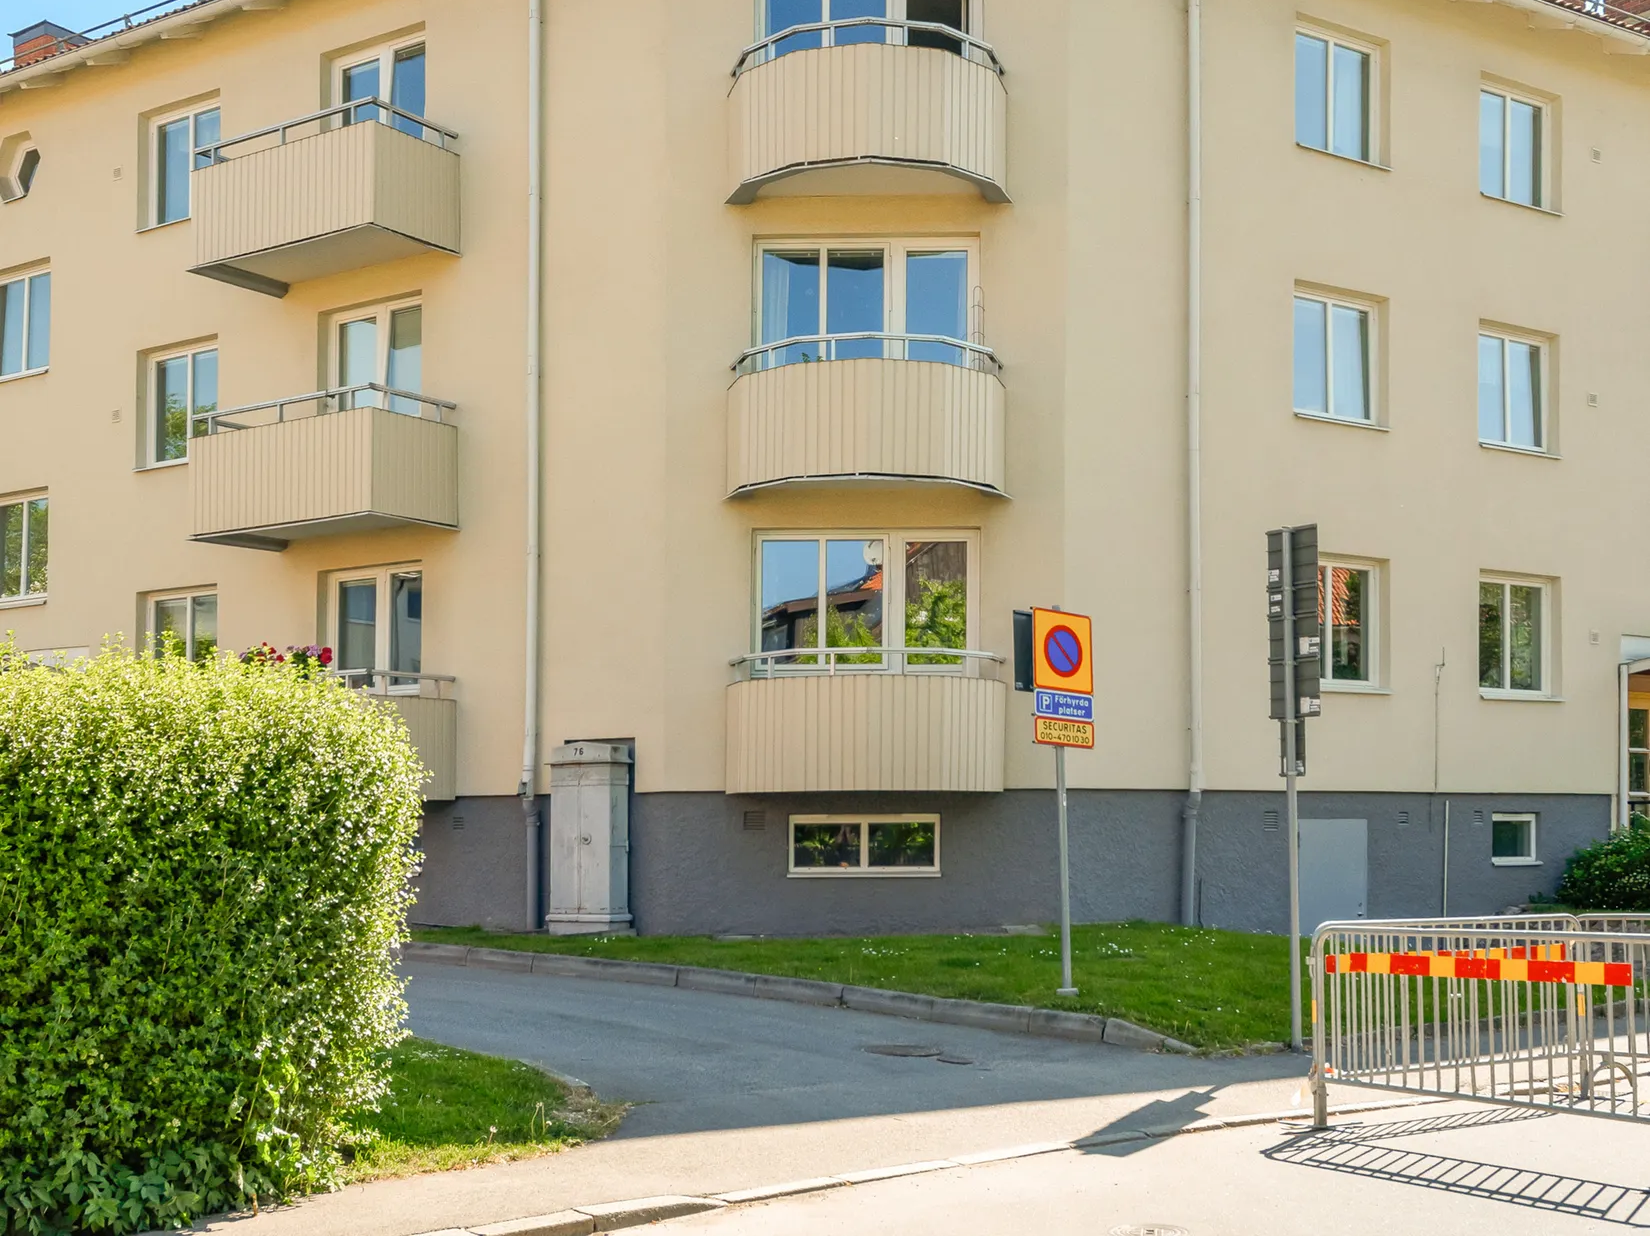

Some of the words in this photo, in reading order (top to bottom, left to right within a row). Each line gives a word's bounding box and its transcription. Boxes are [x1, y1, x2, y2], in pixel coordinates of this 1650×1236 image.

[1042, 695, 1050, 710] P
[1054, 695, 1089, 707] Förhyrda
[1058, 706, 1086, 716] platser
[1043, 720, 1087, 734] SECURITAS
[573, 747, 584, 756] 76
